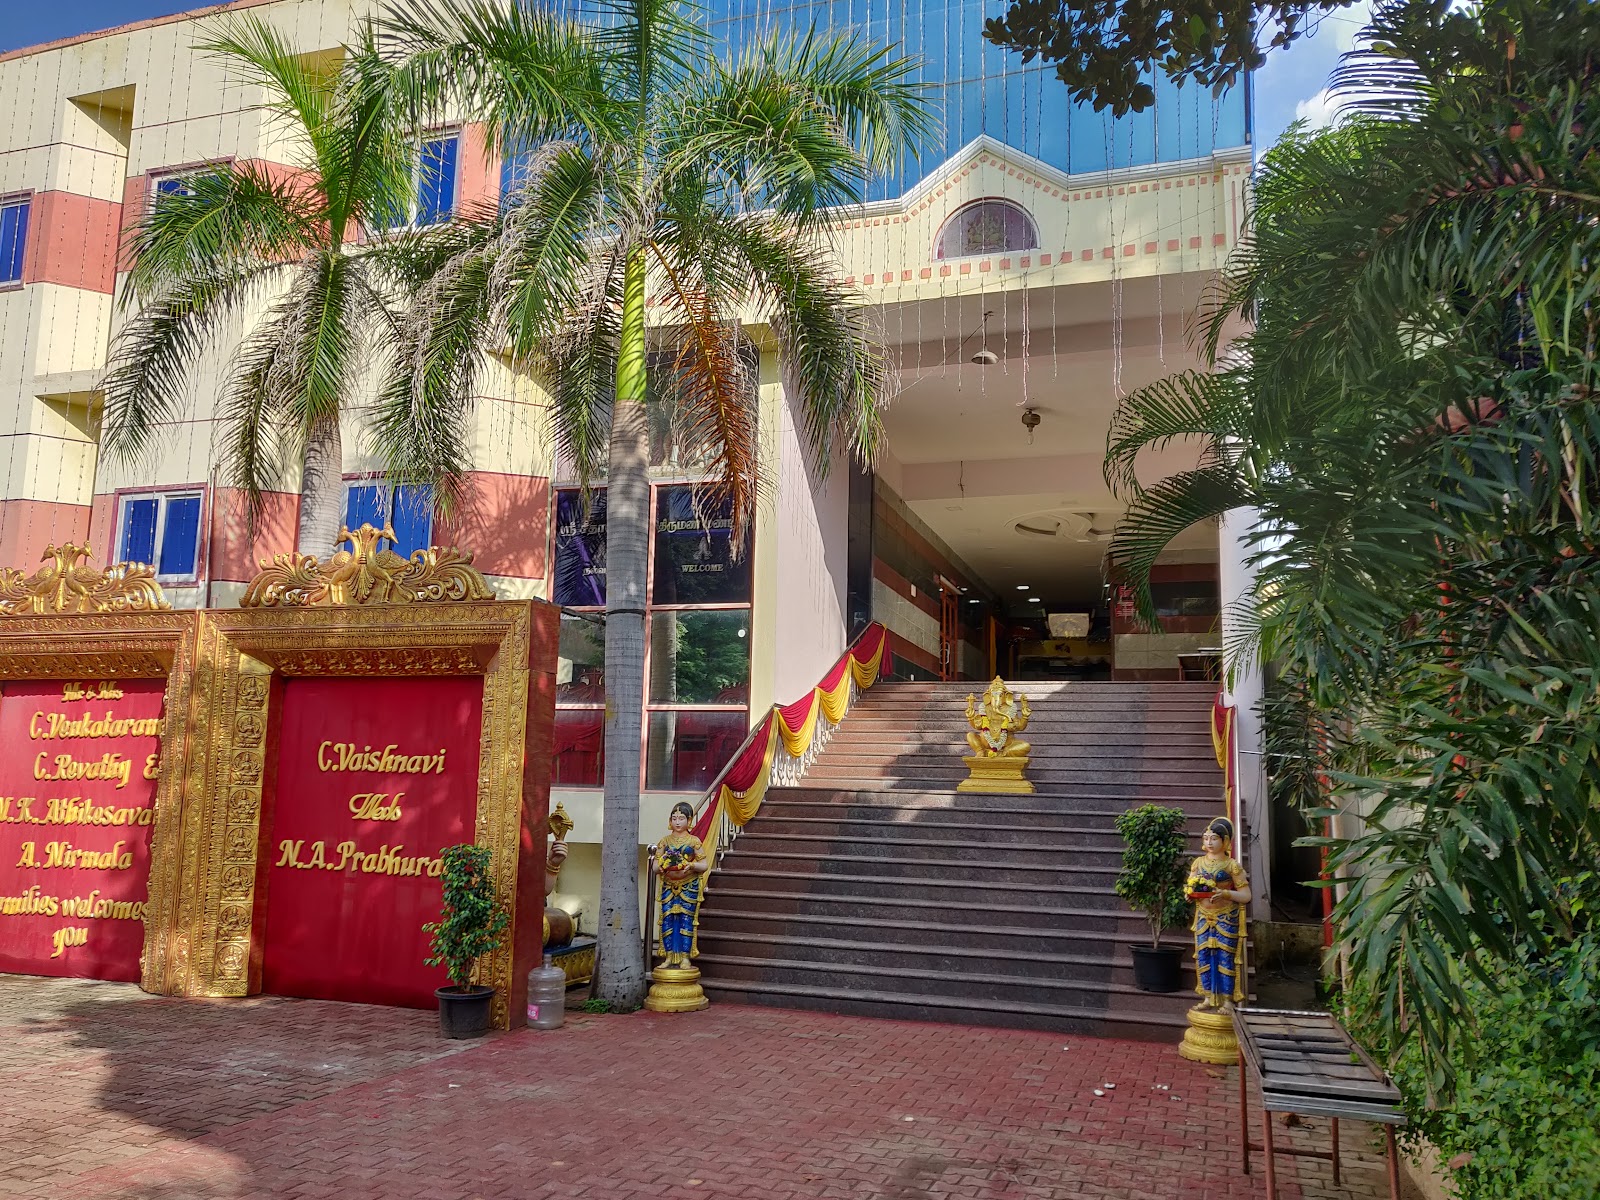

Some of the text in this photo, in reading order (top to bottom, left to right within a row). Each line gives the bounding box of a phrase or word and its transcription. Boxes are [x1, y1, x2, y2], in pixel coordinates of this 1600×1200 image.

[681, 563, 724, 573] WELCOME
[86, 685, 97, 700] &
[317, 741, 447, 774] C.Vaishnavi
[349, 793, 405, 821] Weds
[275, 839, 447, 877] N.A.Prabhura
[50, 926, 89, 958] you
